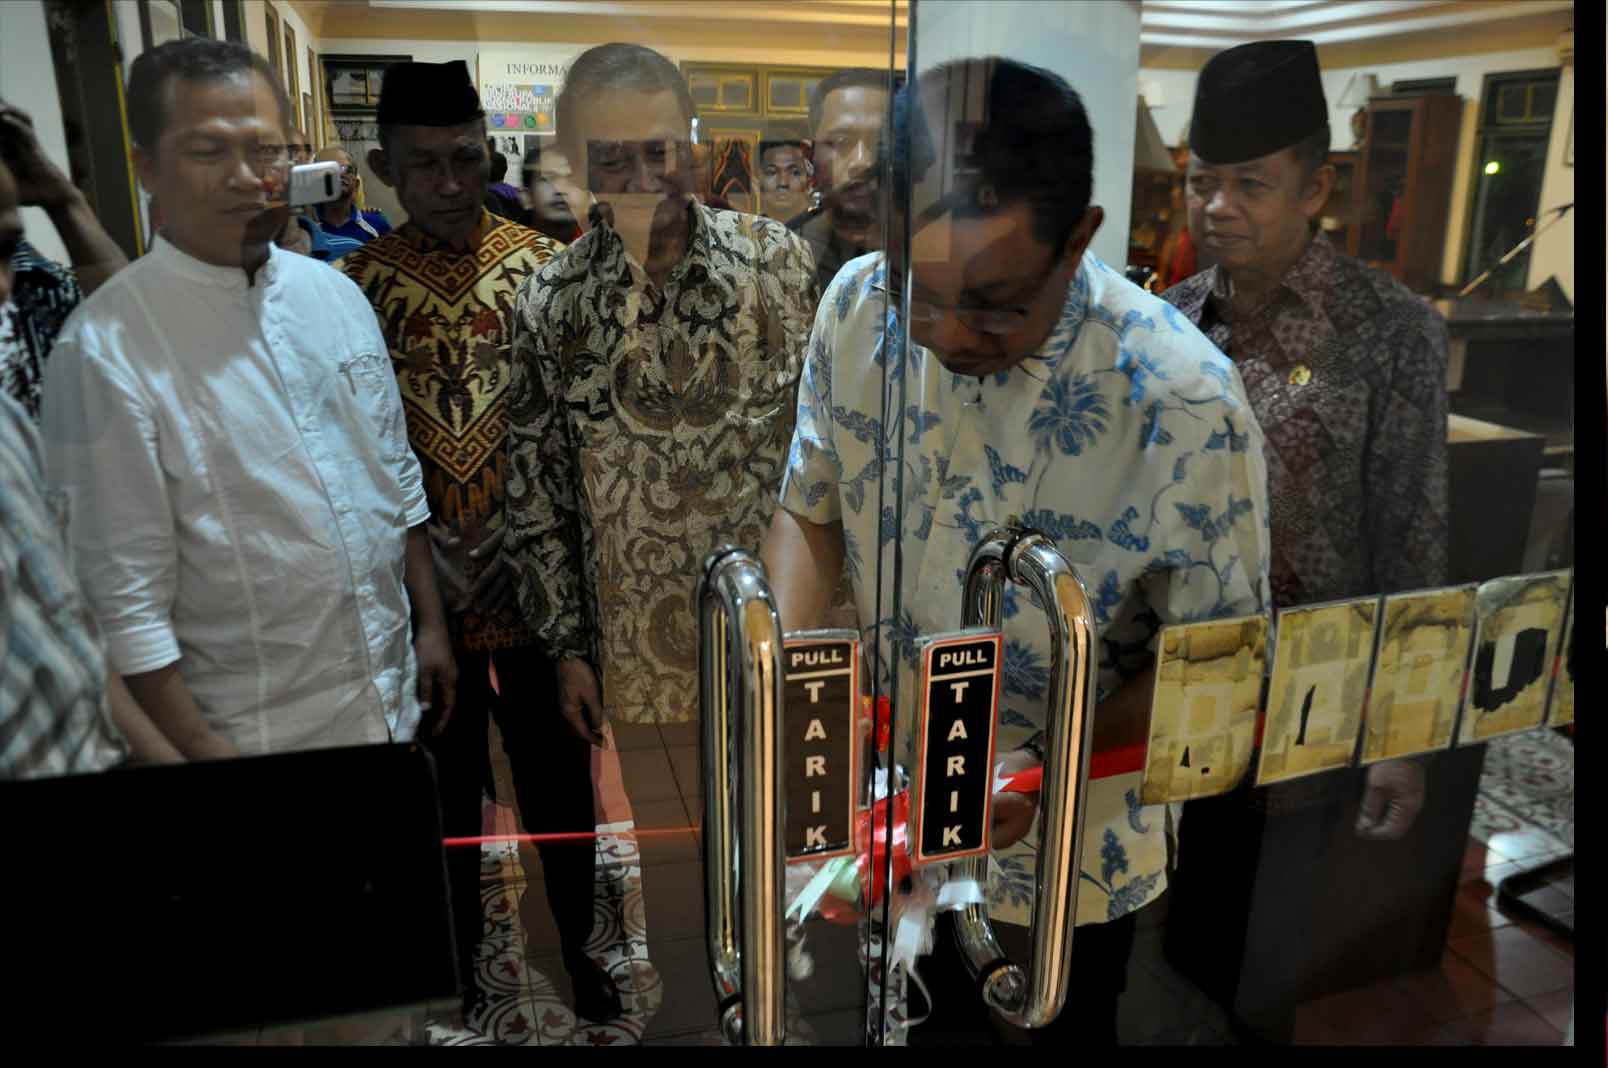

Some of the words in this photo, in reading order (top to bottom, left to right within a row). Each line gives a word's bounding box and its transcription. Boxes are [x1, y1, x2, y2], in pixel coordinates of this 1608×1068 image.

[791, 650, 843, 668] PULL
[940, 649, 988, 668] PULL
[804, 681, 828, 847] TARIK
[942, 681, 970, 846] TARIK
